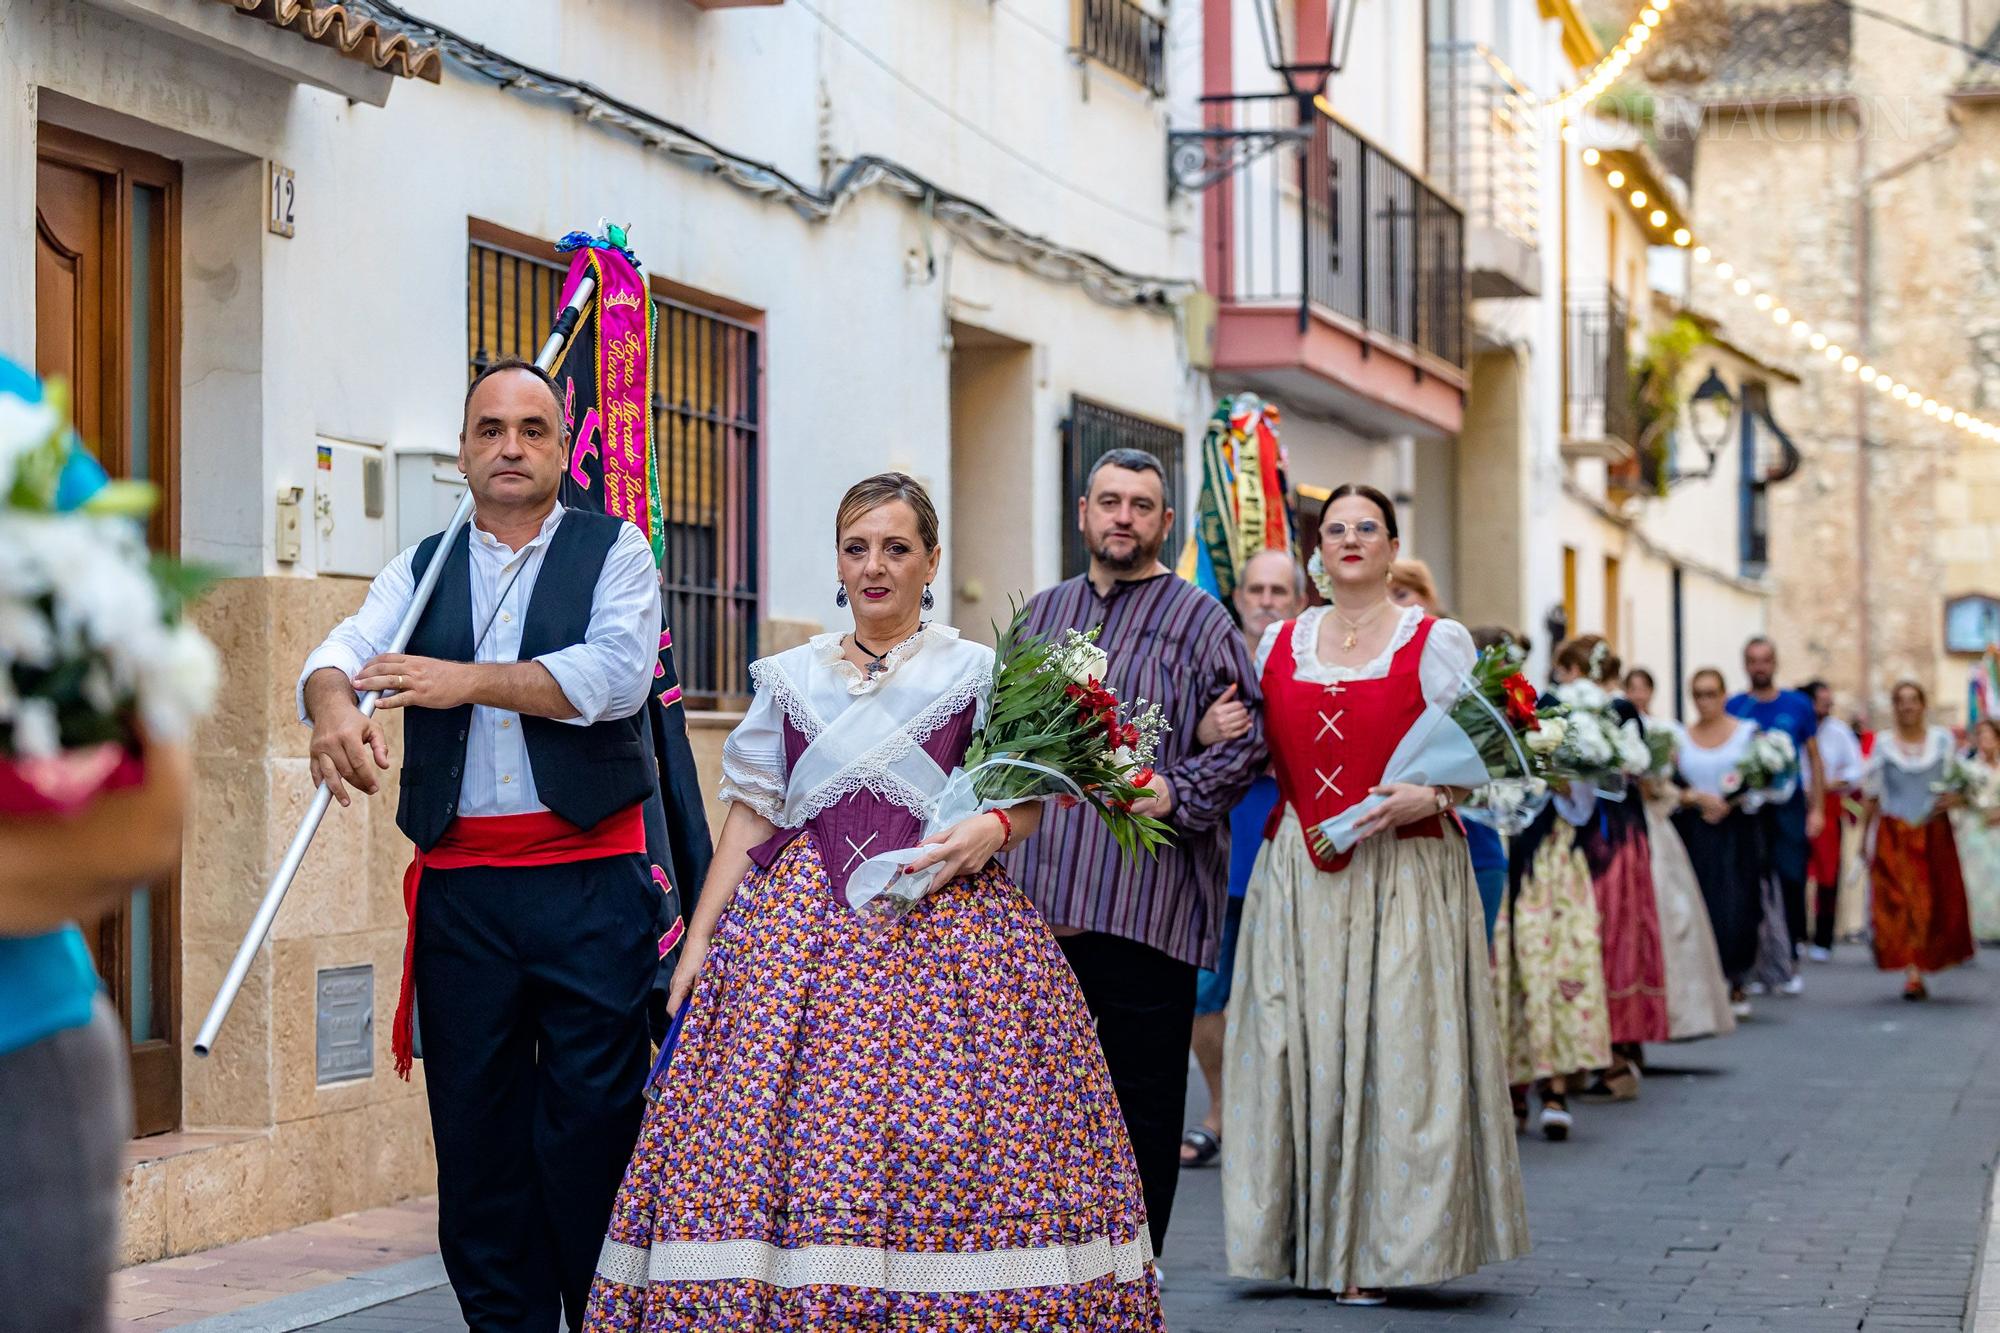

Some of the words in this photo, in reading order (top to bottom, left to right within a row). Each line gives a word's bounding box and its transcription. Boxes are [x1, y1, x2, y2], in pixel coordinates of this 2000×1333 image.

[275, 175, 294, 223] 12
[606, 339, 625, 392] Reina
[624, 331, 641, 389] Teresa
[606, 397, 624, 452] Festes
[622, 392, 641, 466] Mercado
[623, 470, 642, 523] Lloren
